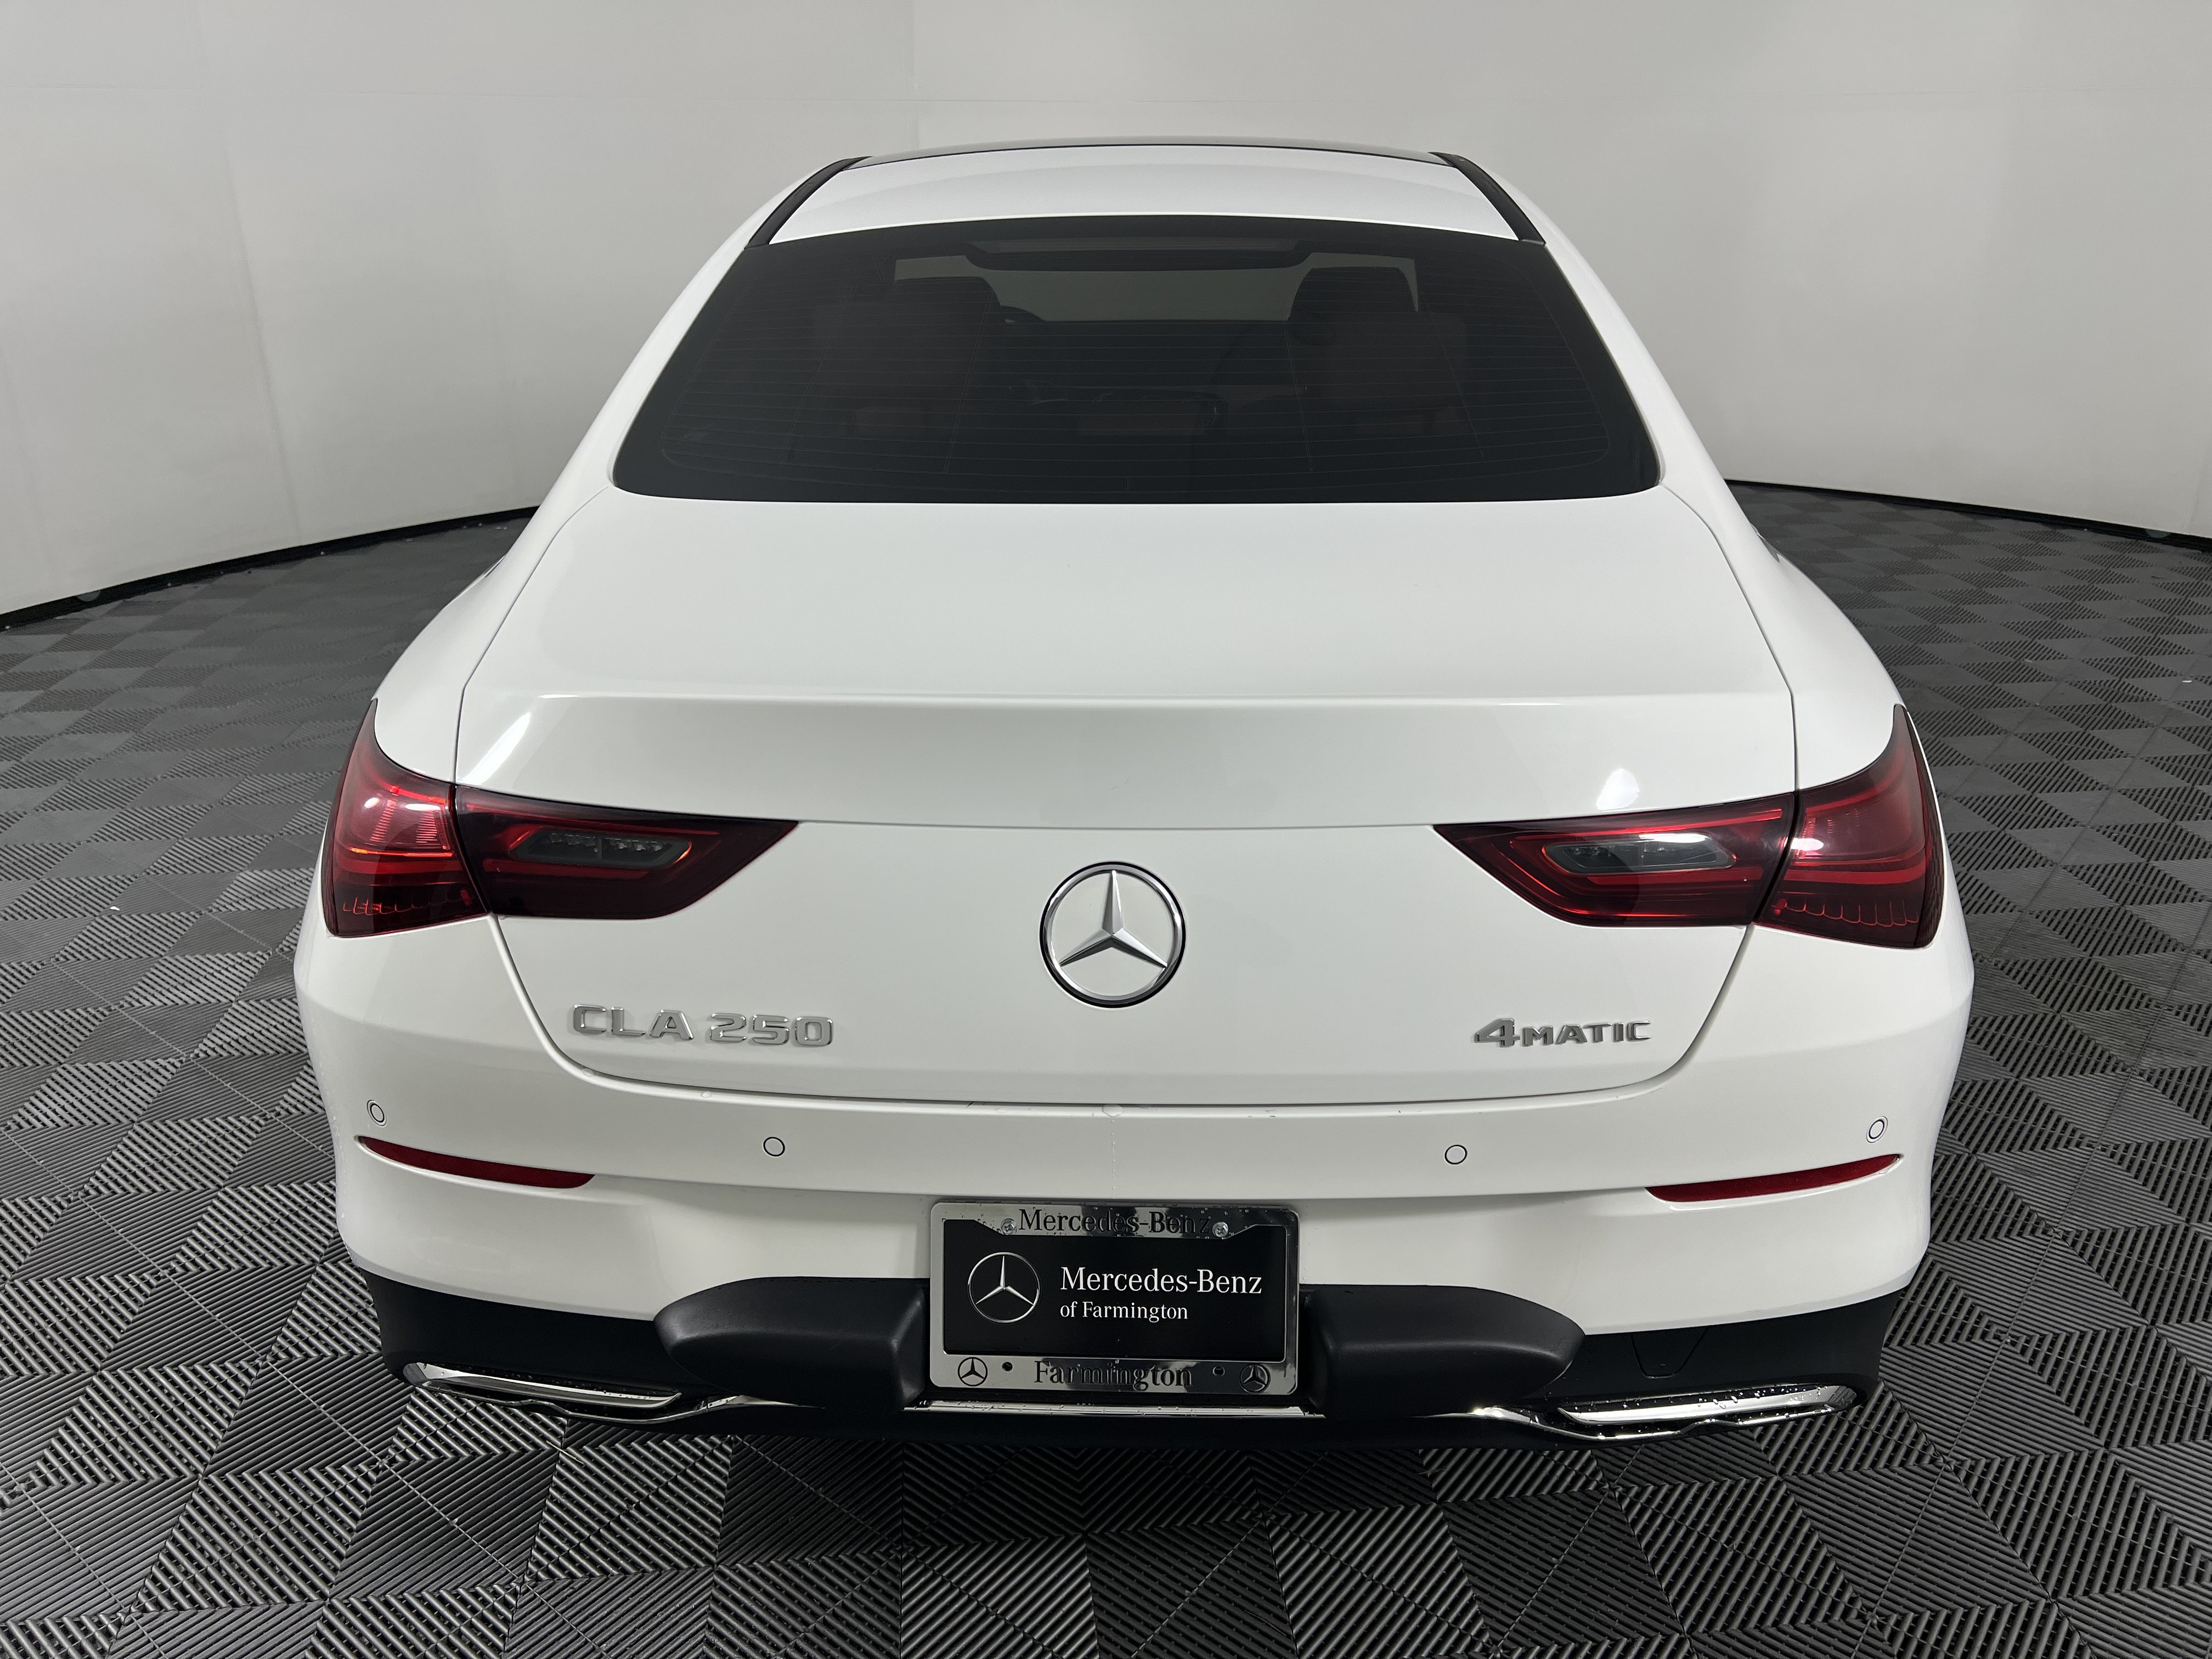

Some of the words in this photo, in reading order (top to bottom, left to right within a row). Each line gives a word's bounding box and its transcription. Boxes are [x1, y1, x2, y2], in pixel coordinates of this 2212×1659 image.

[573, 1004, 693, 1041] CLA
[710, 1013, 834, 1046] 250
[1474, 1018, 1652, 1047] 4MATIC
[1019, 1209, 1211, 1234] Mercedes-Benz
[1060, 1267, 1262, 1294] Mercedes-Benz
[1060, 1301, 1077, 1318] of
[1082, 1301, 1188, 1323] Farmington
[1034, 1361, 1193, 1390] Farmington
